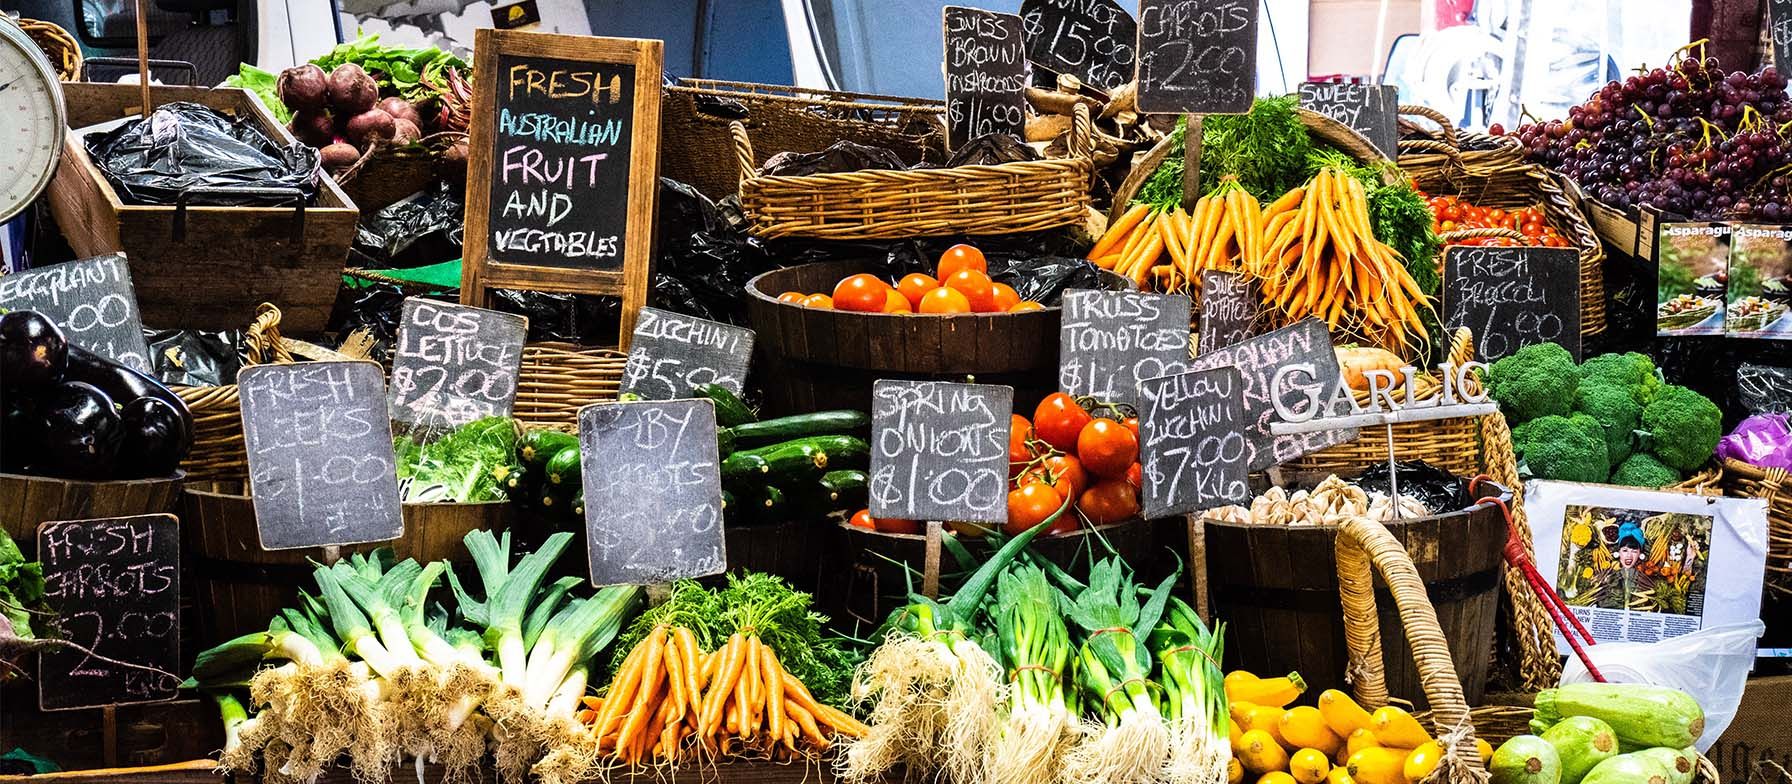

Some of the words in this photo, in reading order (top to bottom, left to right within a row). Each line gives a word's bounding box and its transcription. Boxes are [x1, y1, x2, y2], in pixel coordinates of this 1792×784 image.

[950, 37, 1016, 67] BROWN
[509, 64, 621, 104] FRESH
[1301, 84, 1370, 107] SWEET
[500, 108, 622, 146] AUSTRALIAN
[503, 145, 608, 190] FRUIT
[502, 188, 573, 227] AND
[495, 228, 617, 257] VEGTABLES
[1455, 249, 1528, 278] FRESH
[413, 304, 480, 333] COS
[1064, 291, 1161, 321] TRUSS
[398, 328, 521, 370] LETTUCE
[634, 310, 738, 353] ZUCCHINI
[244, 366, 354, 407] FRESH
[1270, 361, 1489, 423] GARLIC
[250, 404, 372, 454] LEEKS
[871, 453, 1003, 514] $1.00
[1145, 431, 1245, 507] $7.00
[1196, 467, 1246, 503] Kilo
[44, 559, 174, 599] CARROTS
